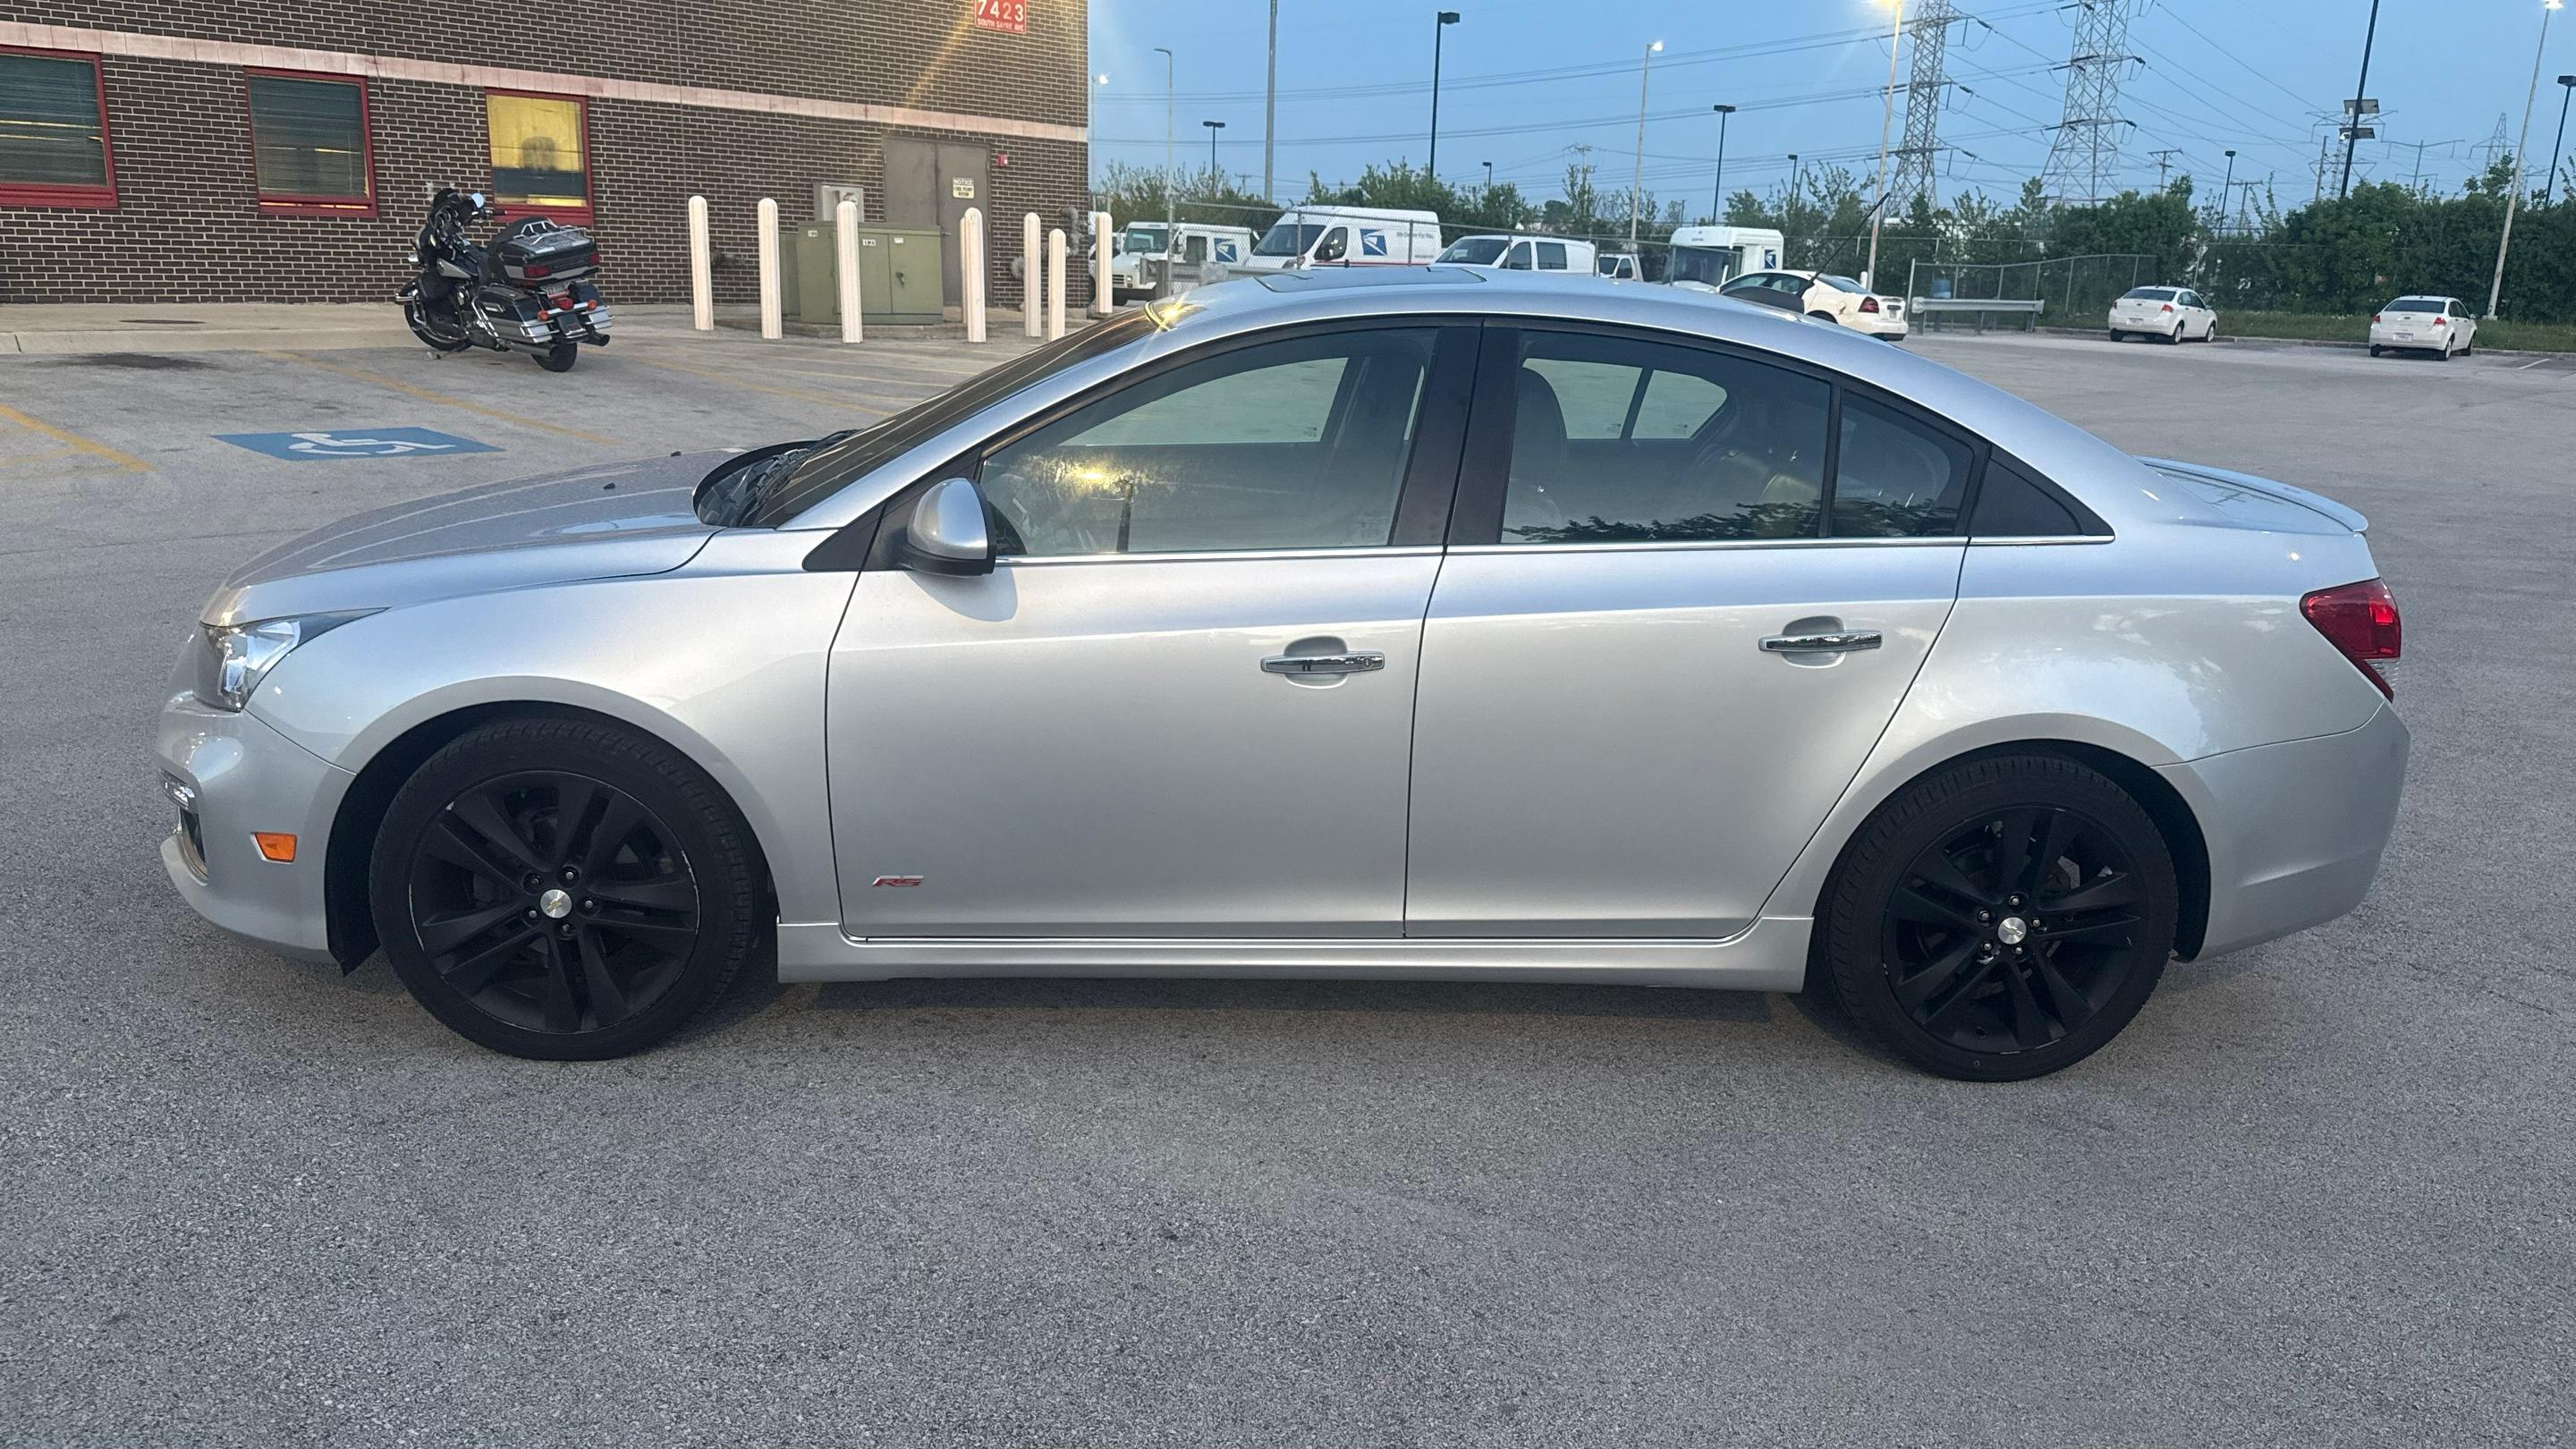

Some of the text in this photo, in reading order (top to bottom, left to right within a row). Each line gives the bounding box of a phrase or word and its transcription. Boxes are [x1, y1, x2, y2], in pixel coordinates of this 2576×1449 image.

[978, 0, 1024, 22] 7423
[978, 18, 996, 27] SOUTH
[872, 875, 924, 887] RS
